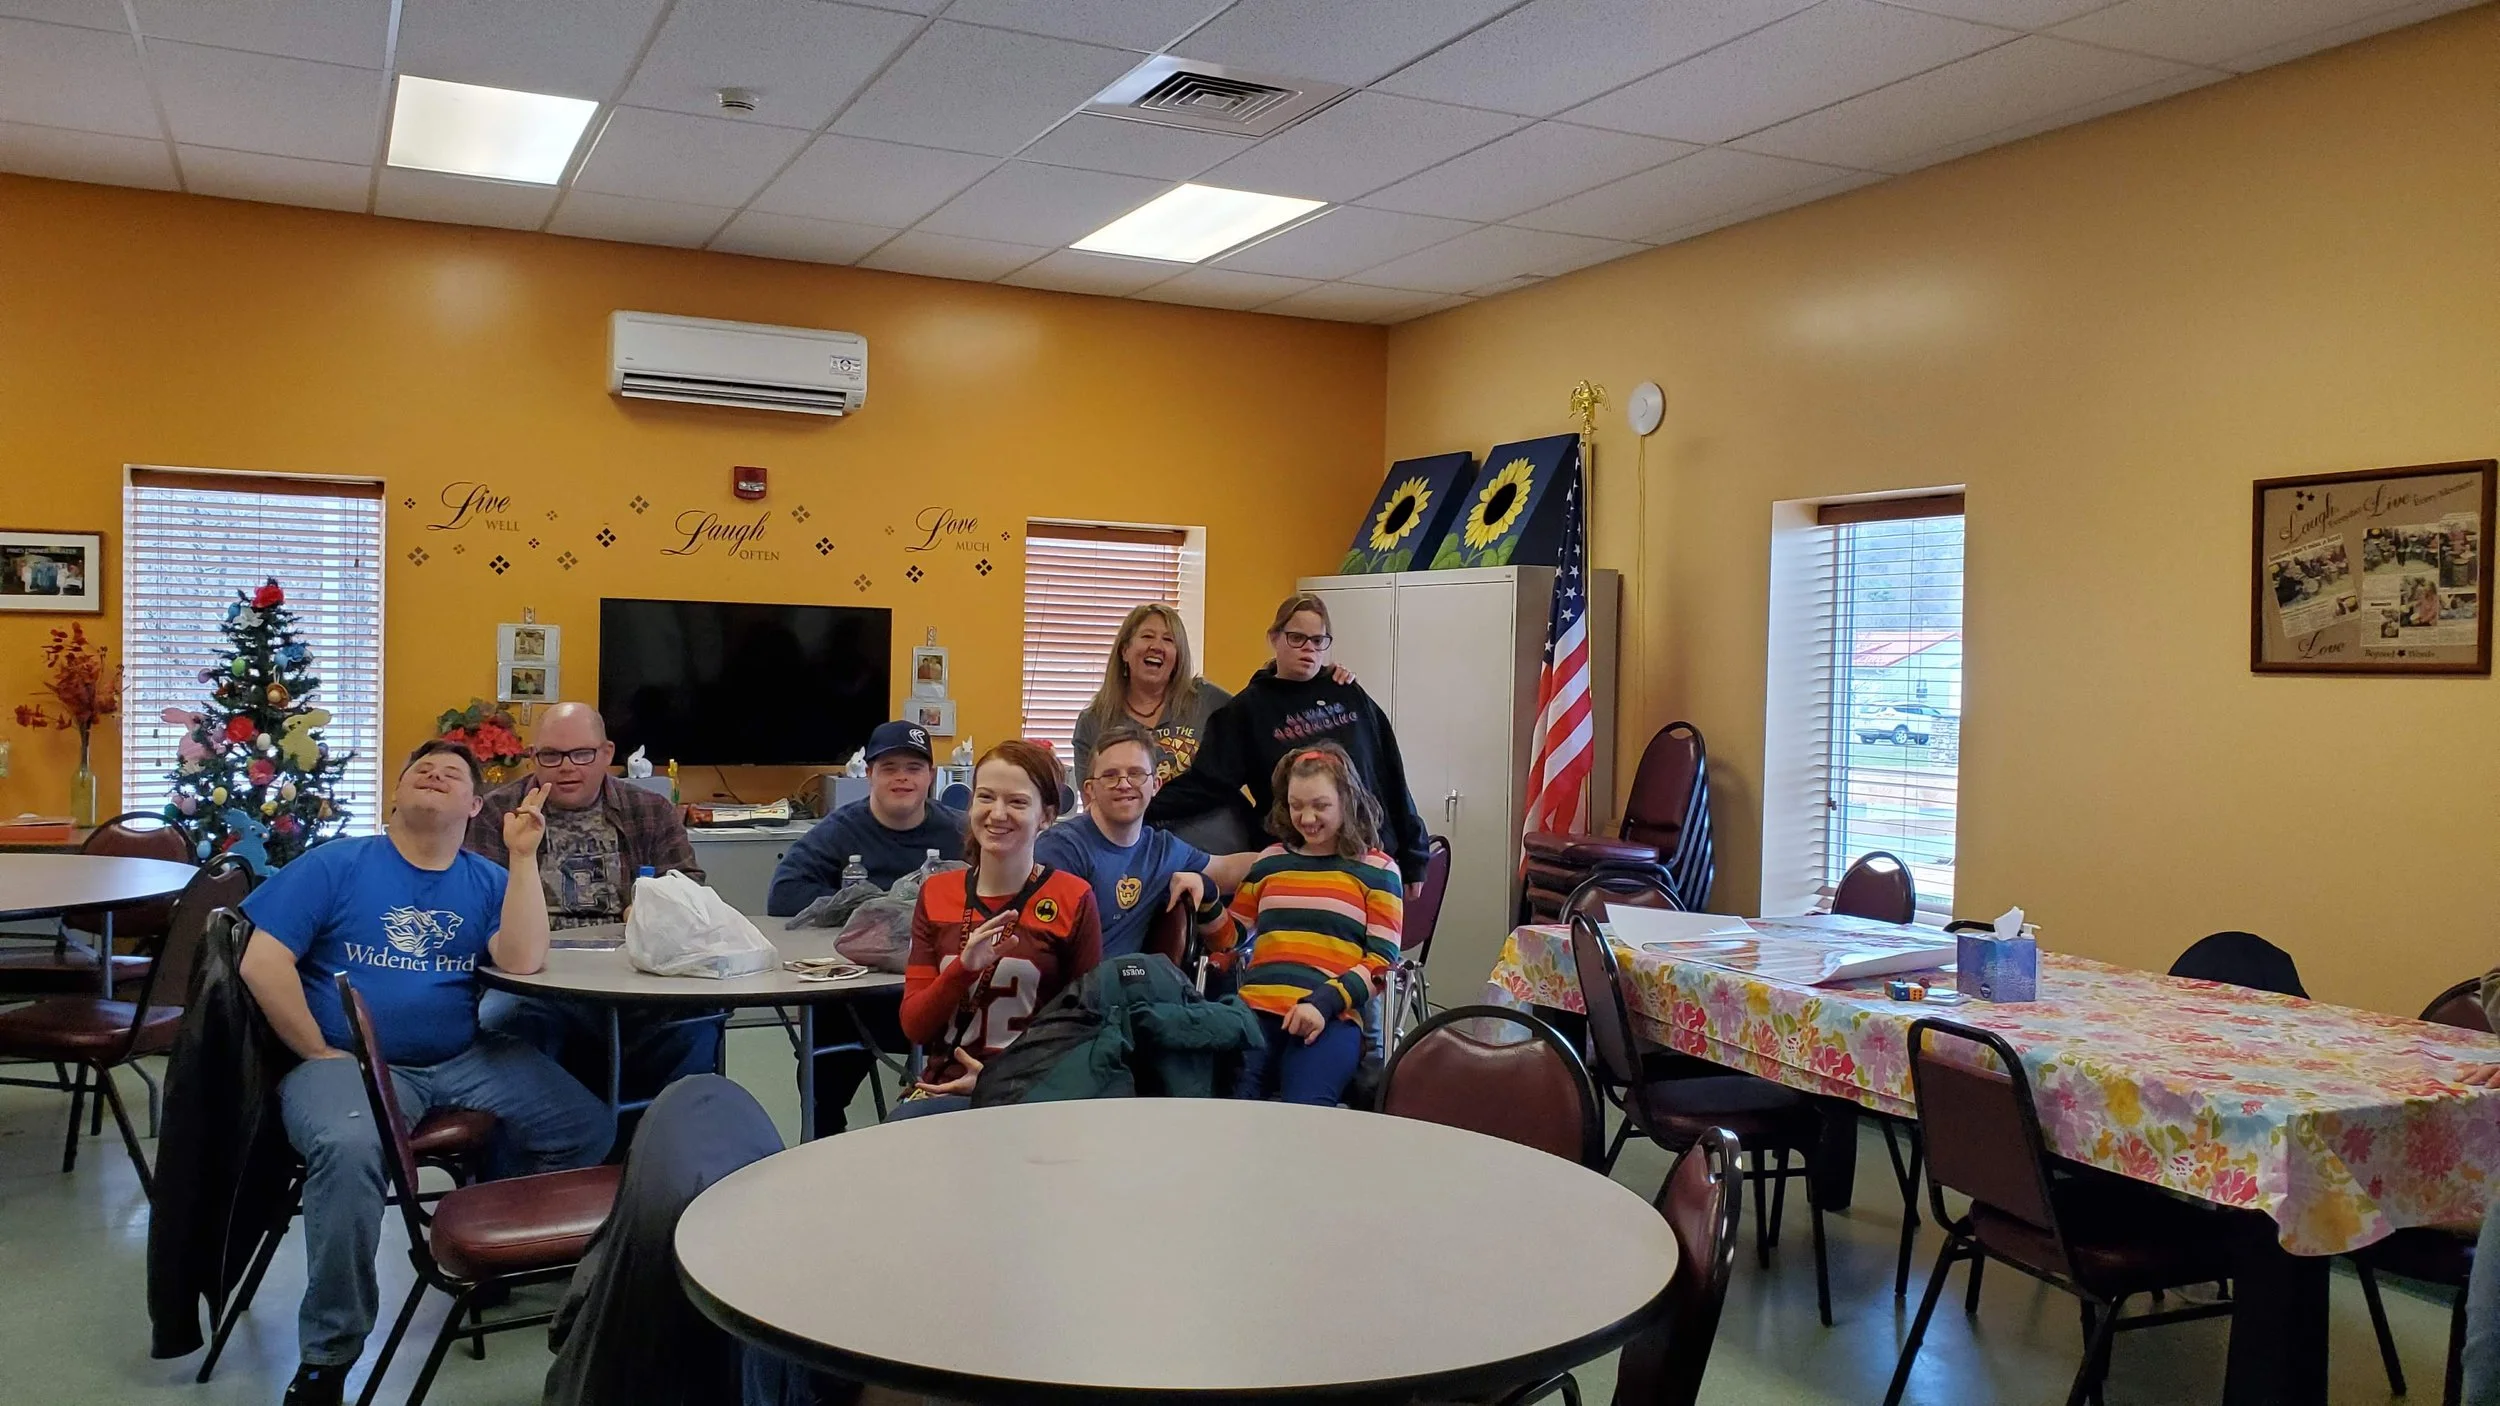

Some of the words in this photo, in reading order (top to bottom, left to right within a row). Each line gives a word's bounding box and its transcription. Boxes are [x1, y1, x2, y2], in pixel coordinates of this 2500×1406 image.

[426, 481, 511, 531] Live
[485, 519, 521, 532] WELL
[660, 509, 771, 557] Laugh
[904, 506, 979, 553] Love
[739, 549, 780, 561] OFTEN
[956, 541, 990, 553] MUCH
[1157, 728, 1170, 738] TO
[1175, 725, 1195, 738] THE
[344, 941, 429, 972] Widener
[435, 953, 477, 972] Prid
